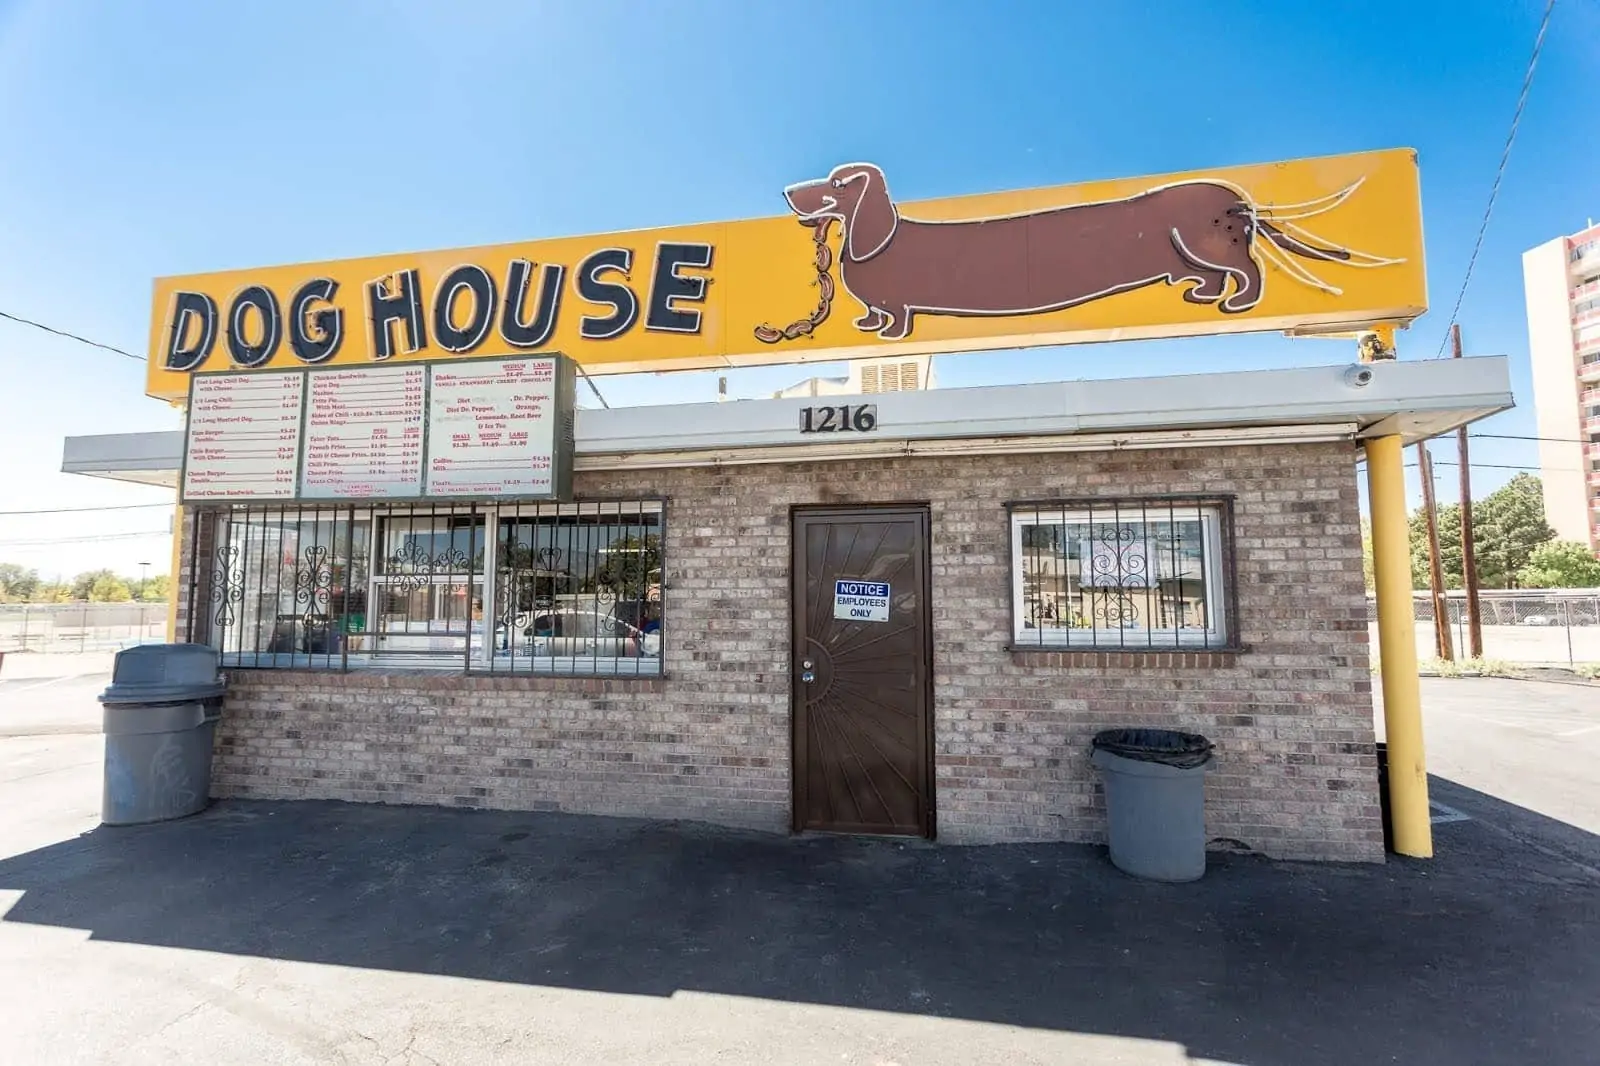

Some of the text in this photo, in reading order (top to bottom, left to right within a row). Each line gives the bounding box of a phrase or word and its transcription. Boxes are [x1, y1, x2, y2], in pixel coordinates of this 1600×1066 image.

[157, 241, 715, 371] DOG HOUSE
[800, 404, 875, 433] 1216
[840, 584, 885, 596] NOTICE
[837, 597, 887, 608] EMPLOYEES
[850, 609, 872, 618] ONLY
